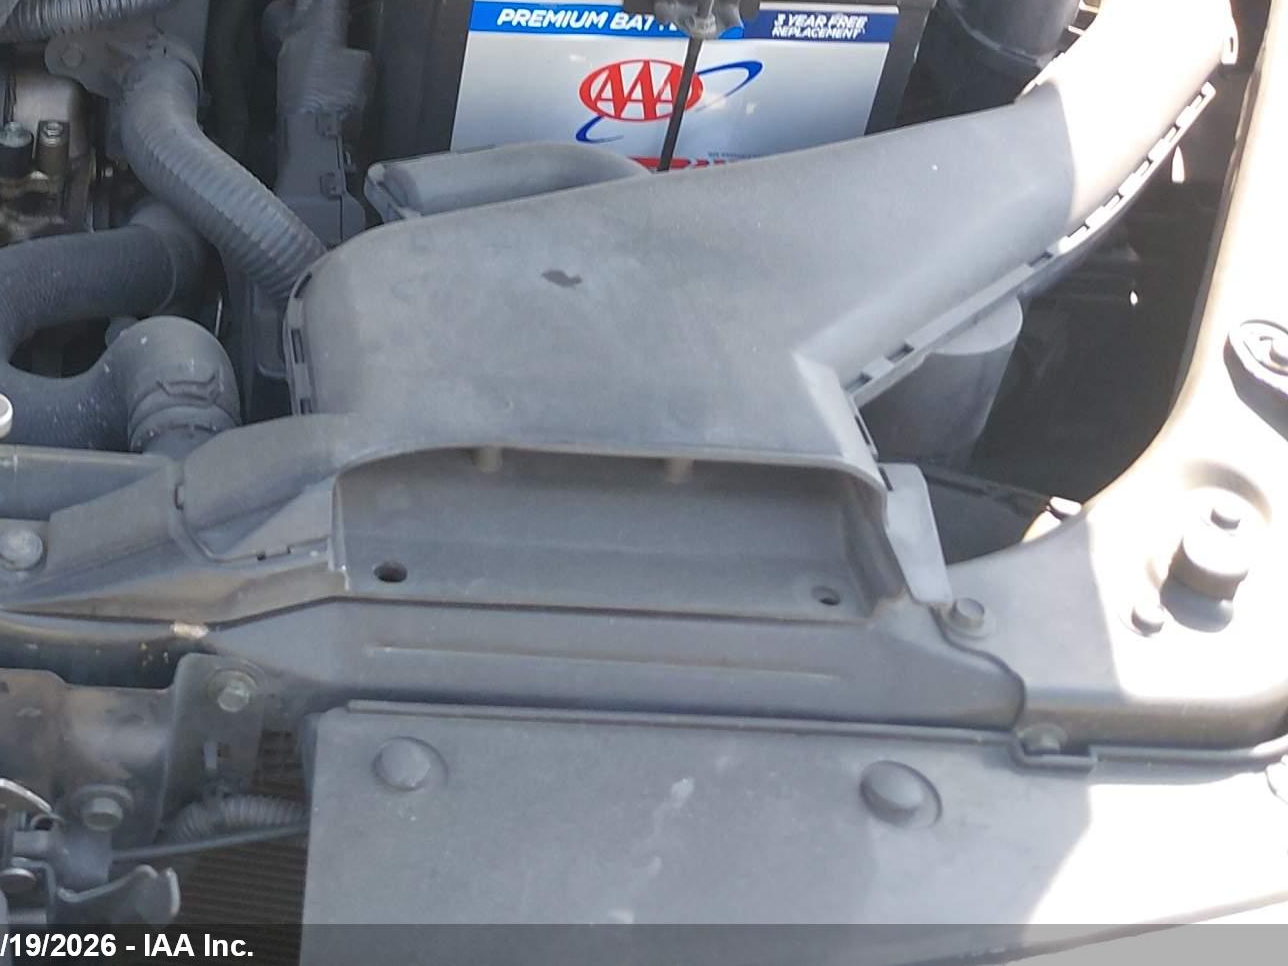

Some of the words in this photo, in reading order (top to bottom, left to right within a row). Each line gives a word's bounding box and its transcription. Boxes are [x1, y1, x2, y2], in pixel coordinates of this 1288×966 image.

[496, 8, 609, 30] PREMIUM
[788, 14, 827, 28] YEAR
[827, 15, 868, 29] FREE
[584, 59, 702, 121] AAA
